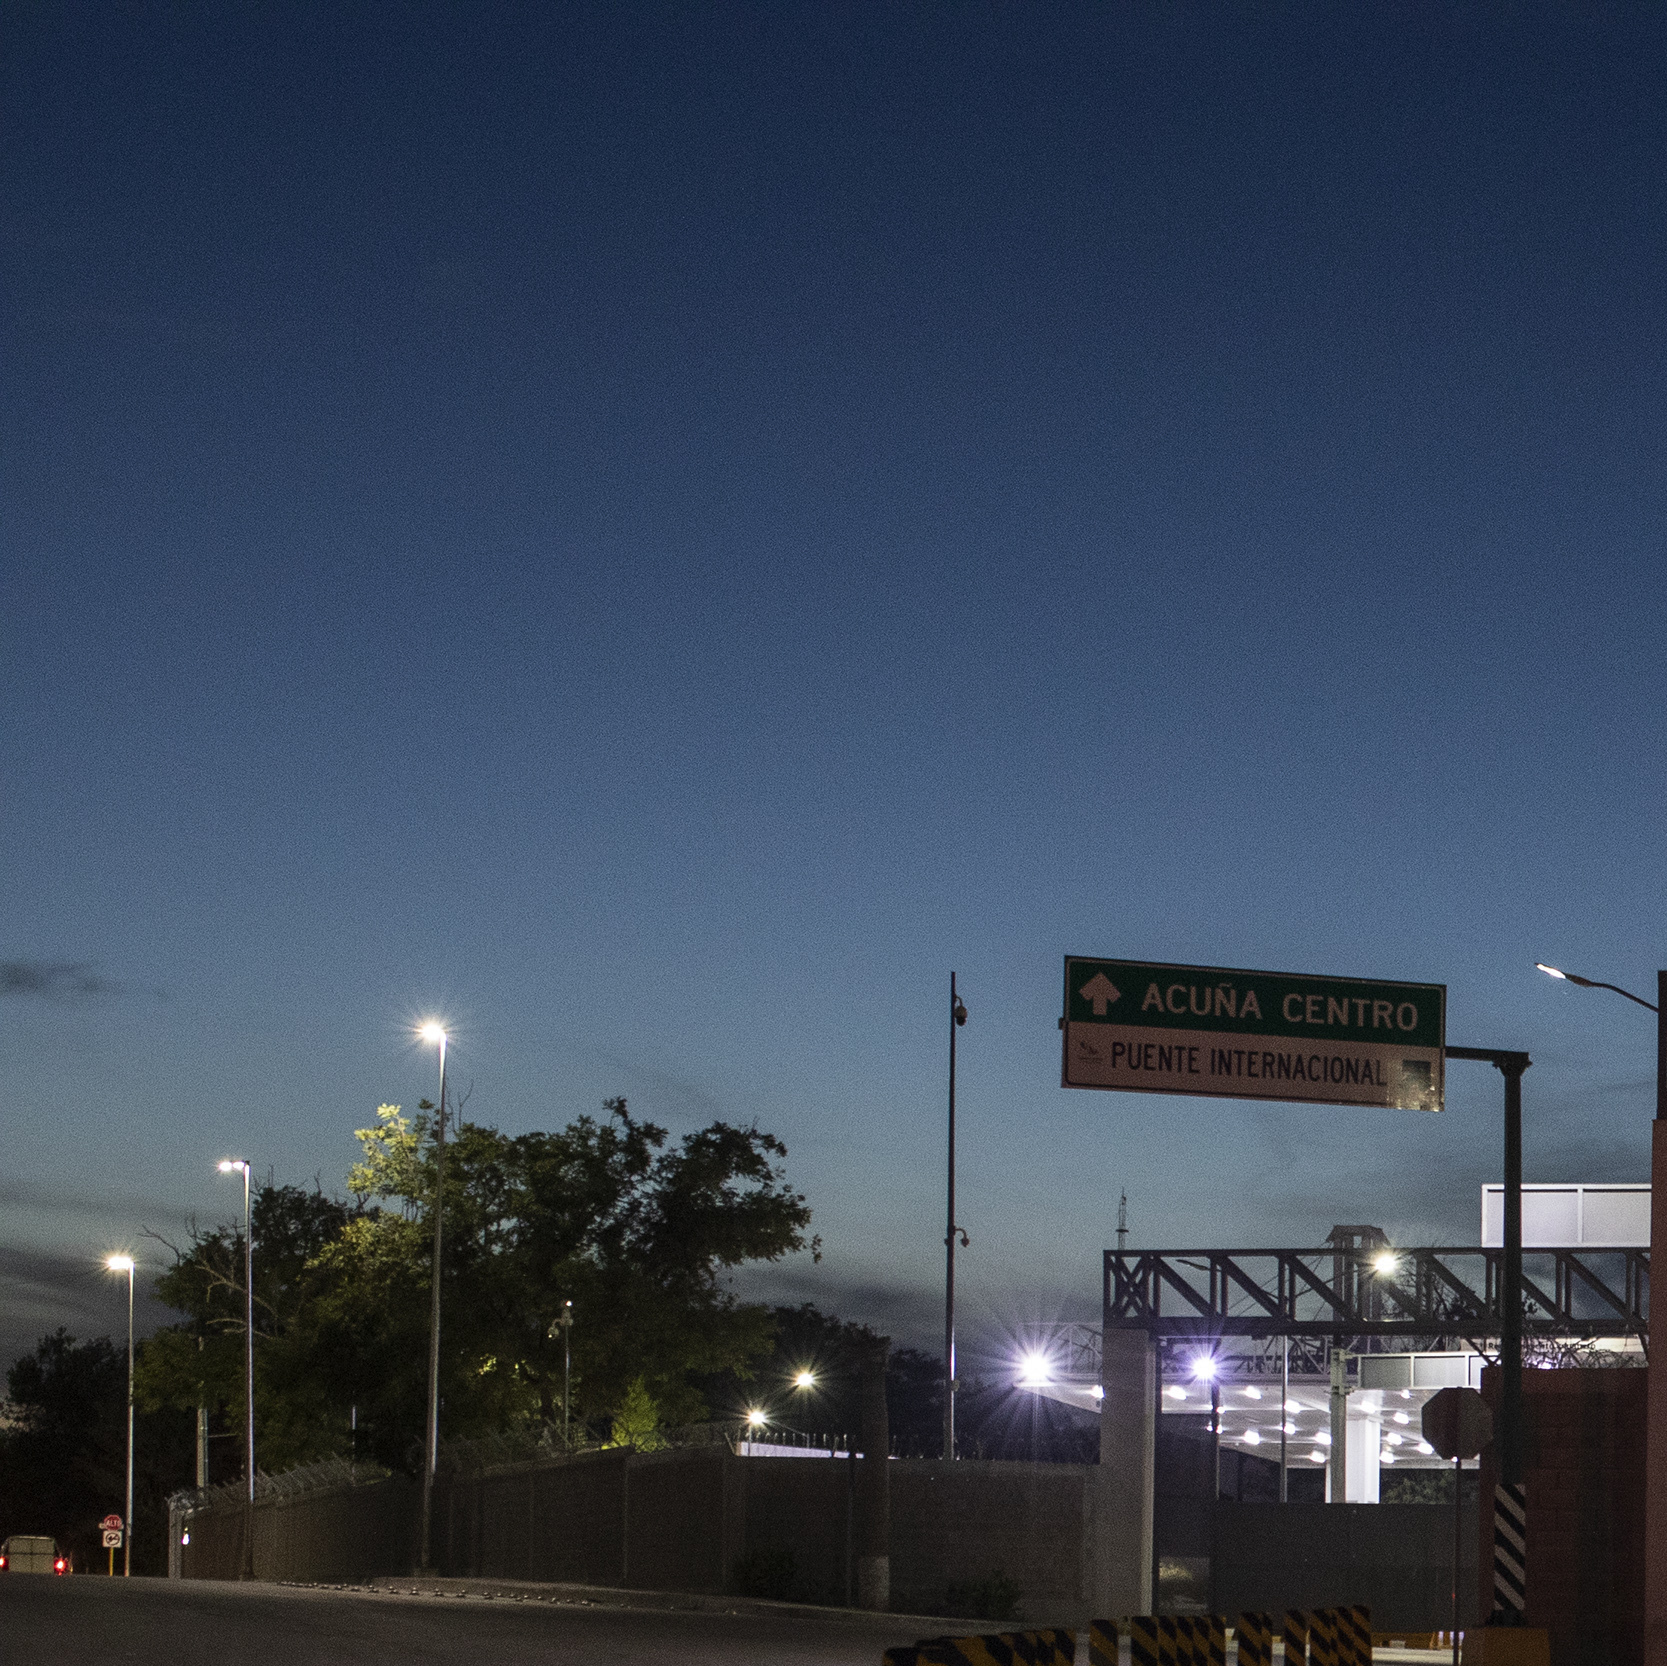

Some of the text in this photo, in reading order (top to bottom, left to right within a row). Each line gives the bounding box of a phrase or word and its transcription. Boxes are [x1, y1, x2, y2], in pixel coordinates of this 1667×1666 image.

[1141, 982, 1418, 1032] ACUÑA CENTRO
[1111, 1041, 1387, 1087] PUENTE INTERNACIONAL
